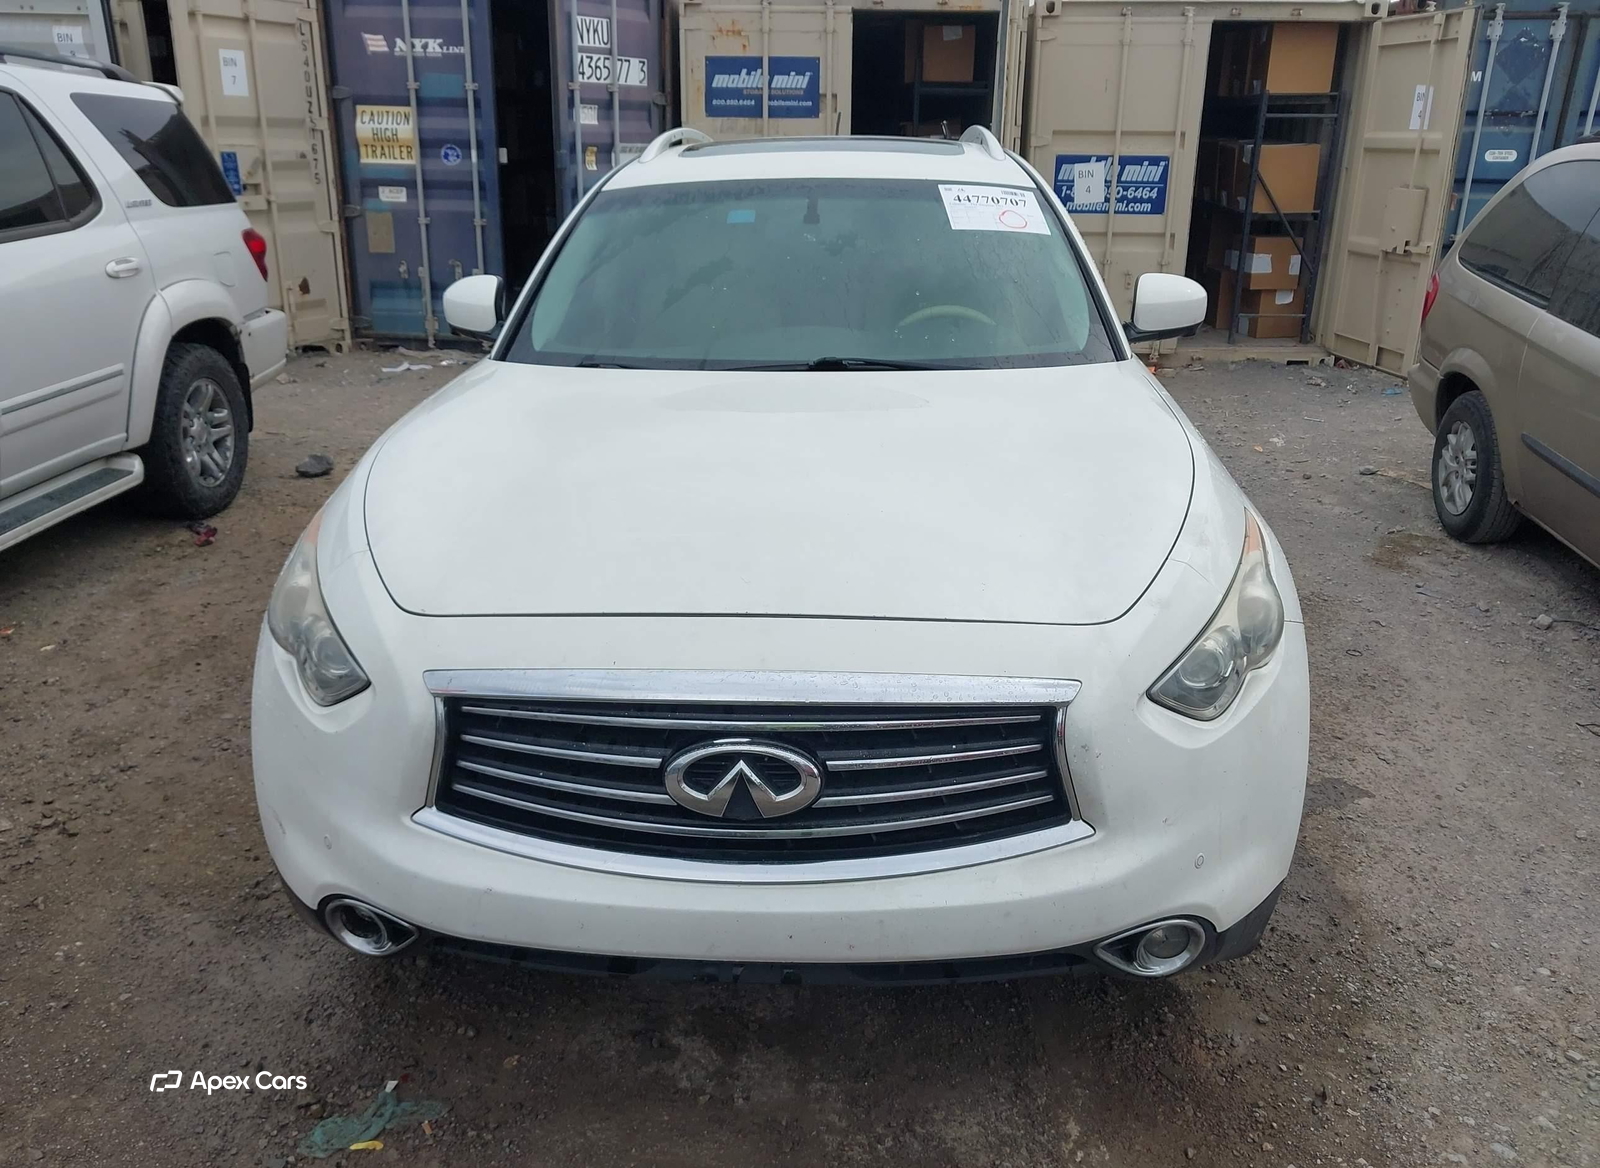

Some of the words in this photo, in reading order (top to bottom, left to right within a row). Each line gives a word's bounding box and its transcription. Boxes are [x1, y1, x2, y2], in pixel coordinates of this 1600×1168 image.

[57, 32, 73, 43] BIN
[577, 18, 610, 46] NYKU
[394, 37, 443, 52] NYK
[222, 56, 238, 67] BIN
[638, 60, 646, 84] 3
[771, 71, 811, 88] mini
[231, 75, 237, 85] 7
[360, 110, 411, 126] CAUTION
[372, 127, 400, 142] HIGH
[363, 144, 413, 160] TRAILER
[1078, 169, 1094, 179] BIN
[1121, 161, 1166, 182] mini
[1085, 185, 1091, 194] 4
[953, 194, 1027, 207] 44770707
[1066, 201, 1151, 212] mobilemni.com
